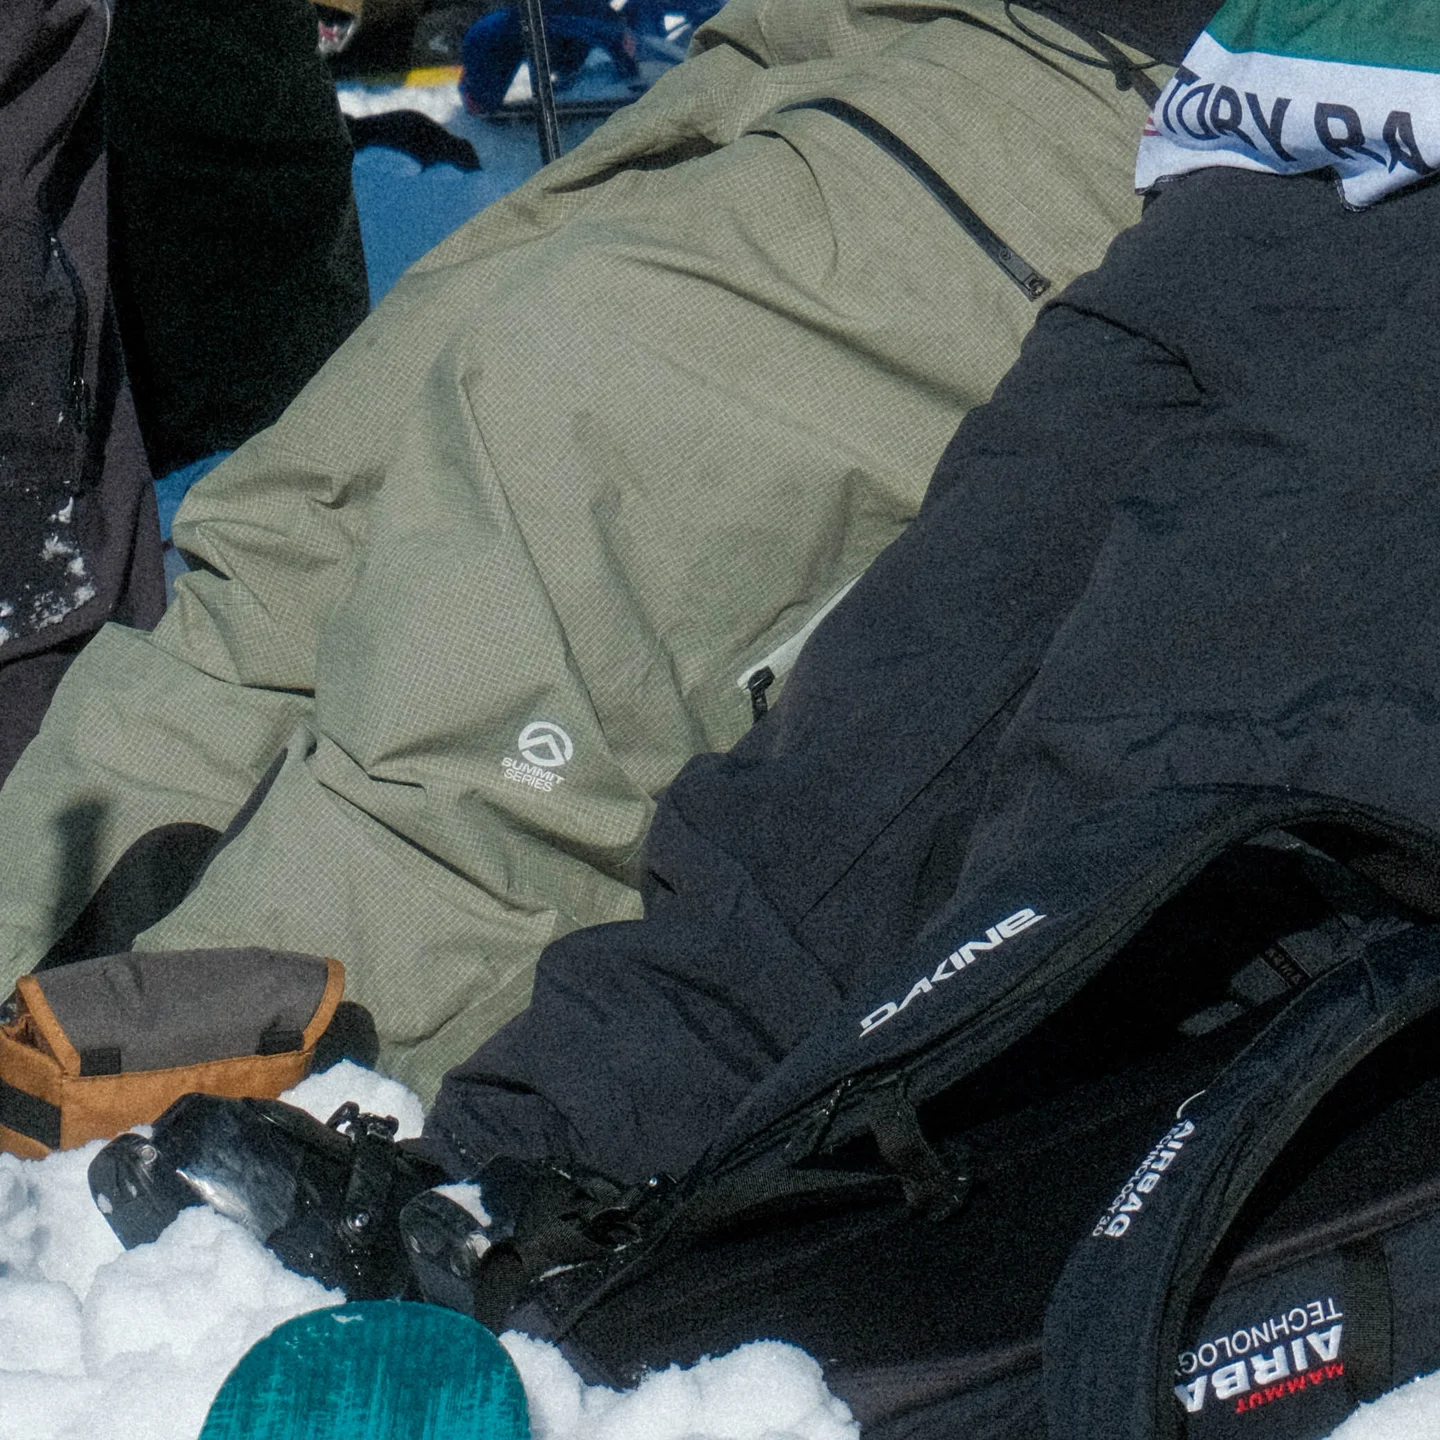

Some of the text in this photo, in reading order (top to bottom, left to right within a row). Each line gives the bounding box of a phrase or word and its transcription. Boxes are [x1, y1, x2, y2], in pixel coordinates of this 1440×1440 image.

[501, 757, 566, 785] SUMMIT
[503, 768, 553, 792] SERIES
[859, 908, 1047, 1038] DAKINE
[1104, 1120, 1195, 1237] AIRBAG
[1174, 1297, 1344, 1377] TECHNOLOG
[1235, 1362, 1344, 1415] MAMMUT
